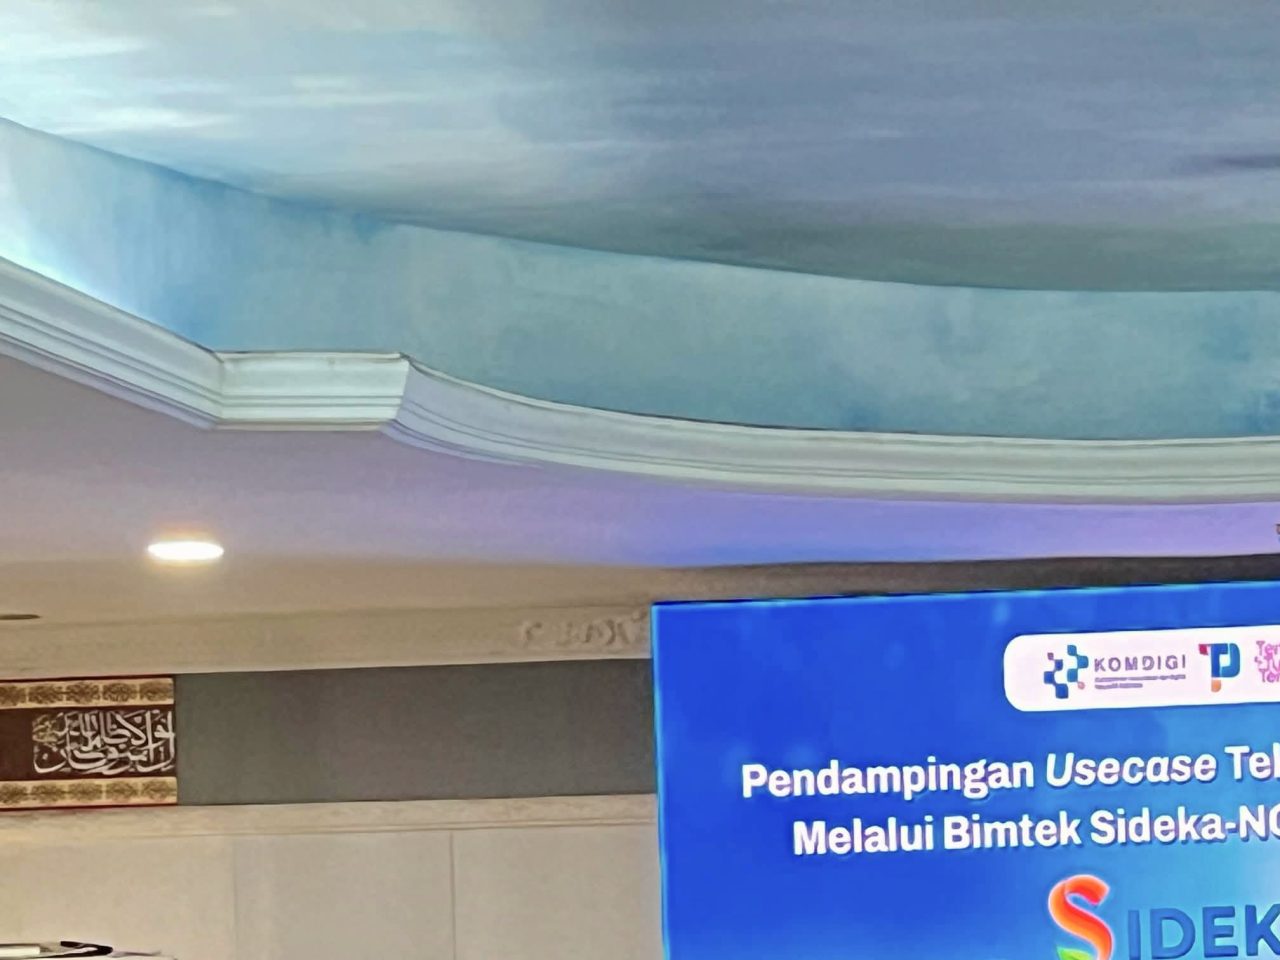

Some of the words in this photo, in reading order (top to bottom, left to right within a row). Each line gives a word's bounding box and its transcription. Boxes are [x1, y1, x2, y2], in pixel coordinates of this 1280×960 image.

[1094, 654, 1186, 672] KOMDIGI
[741, 754, 1035, 802] Pendampingan
[1045, 751, 1218, 788] Usecase
[792, 814, 934, 856] Melalui
[943, 810, 1082, 851] Bimtek
